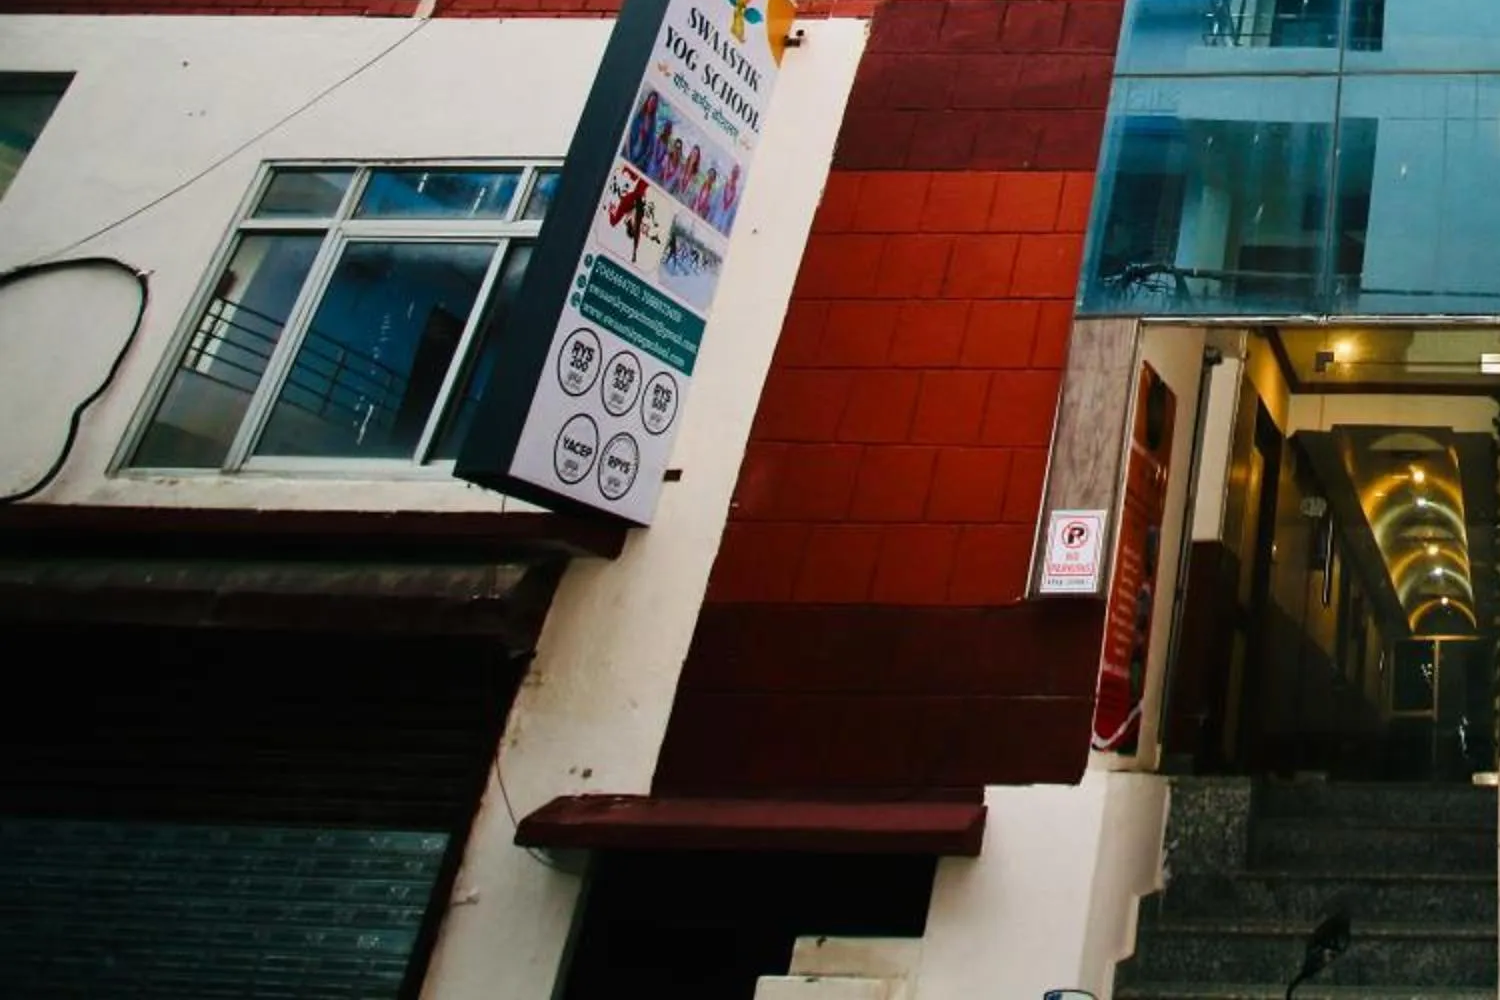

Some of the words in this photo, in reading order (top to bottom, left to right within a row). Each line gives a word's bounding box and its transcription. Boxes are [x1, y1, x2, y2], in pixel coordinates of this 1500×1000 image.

[688, 7, 762, 92] SWAASTIK
[665, 24, 700, 72] YOG
[702, 63, 760, 133] SCHOOL
[572, 341, 595, 362] RYS
[570, 358, 589, 373] 200
[614, 363, 635, 383] RYS
[653, 383, 673, 403] RYS
[563, 436, 593, 458] YACEP
